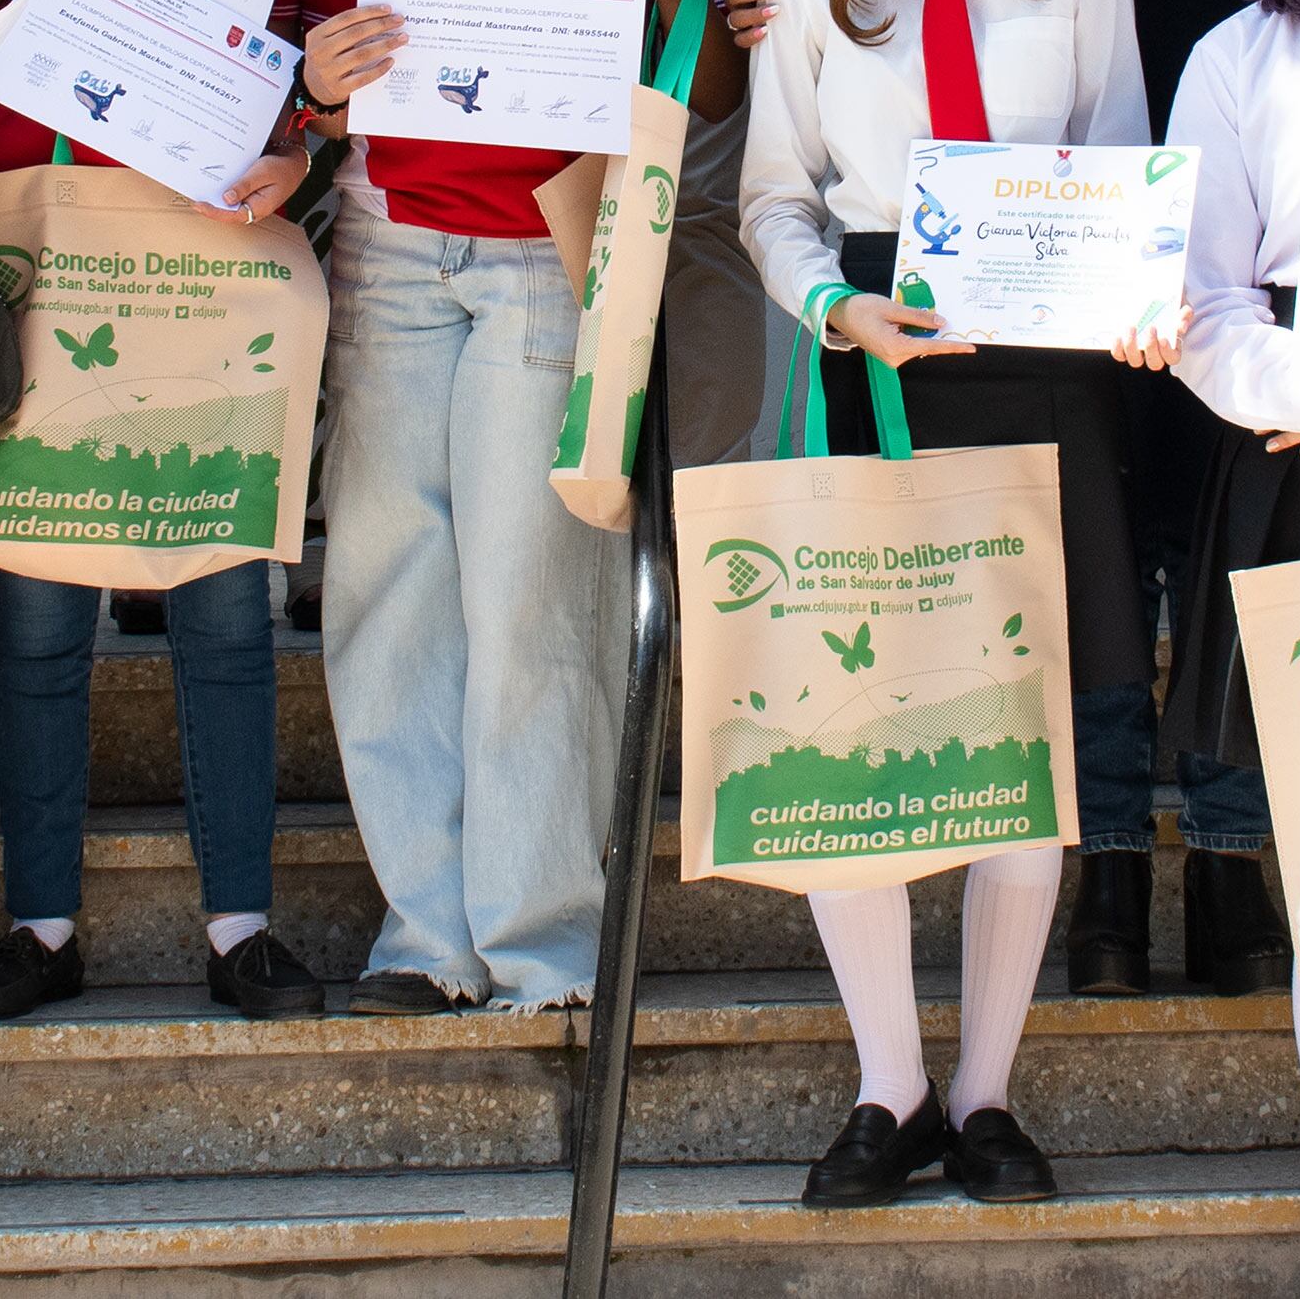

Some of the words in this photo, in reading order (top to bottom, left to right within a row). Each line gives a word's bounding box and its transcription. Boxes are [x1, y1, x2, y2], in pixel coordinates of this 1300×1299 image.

[442, 18, 482, 29] Trinidad
[485, 21, 543, 33] Mastrandrea
[551, 27, 571, 35] DNI:
[573, 27, 620, 39] 48955440
[101, 31, 137, 52] Gabriela
[138, 49, 173, 69] Mackow
[199, 80, 241, 104] 49462677
[994, 178, 1124, 201] DIPLOMA
[997, 210, 1016, 218] Este
[1017, 210, 1063, 220] certificado
[977, 221, 1025, 240] Gianna
[1026, 221, 1078, 242] Victoria
[1035, 241, 1069, 261] Silva
[37, 246, 137, 277] Concejo
[145, 251, 292, 281] Deliberante
[35, 276, 53, 290] de
[57, 276, 84, 292] San
[87, 276, 150, 296] Salvador
[156, 281, 174, 296] de
[177, 281, 216, 299] Jujuy
[134, 304, 170, 320] cdjujuy
[192, 305, 227, 320] cdjujuy
[118, 488, 142, 513] la
[147, 488, 240, 514] ciudad
[125, 518, 151, 541] el
[155, 518, 234, 542] futuro
[793, 544, 879, 574] Concejo
[883, 533, 1025, 571] Deliberante
[796, 576, 815, 591] de
[820, 575, 846, 590] San
[849, 576, 892, 591] Salvador
[895, 576, 913, 591] de
[916, 571, 955, 590] Jujuy
[936, 591, 973, 609] cdjujuy
[749, 796, 893, 826] cuidando
[899, 793, 925, 818] la
[930, 780, 1029, 814] ciudad
[752, 825, 905, 856] cuidamos
[910, 820, 937, 845] el
[942, 813, 1030, 843] futuro
